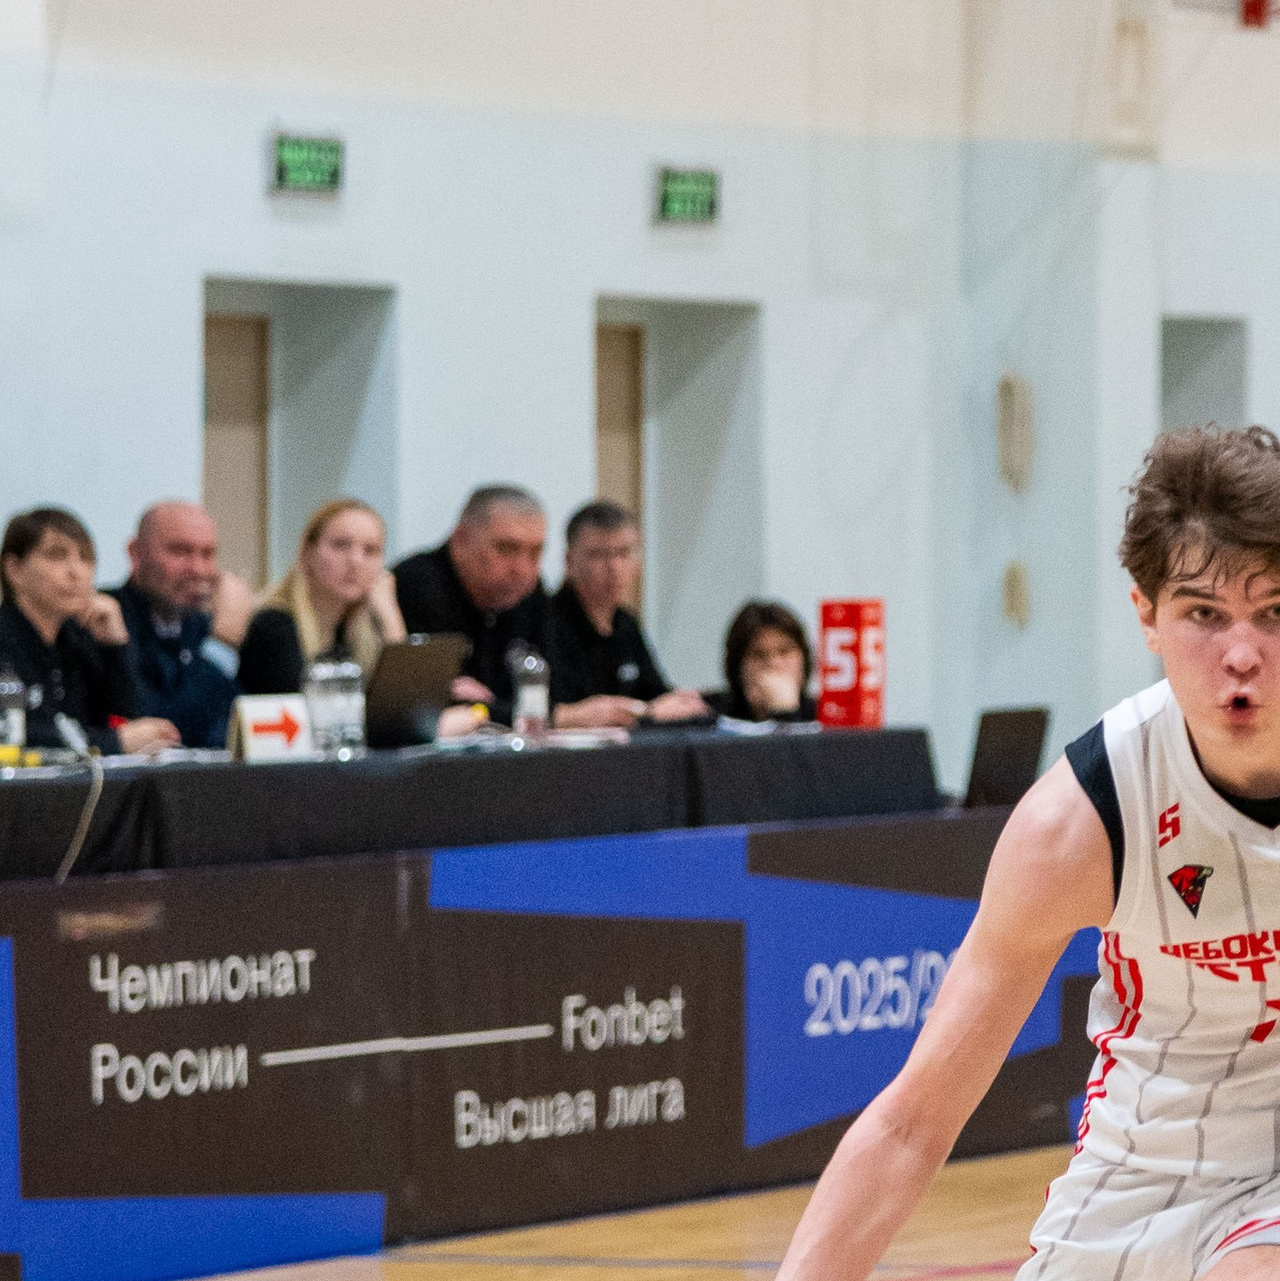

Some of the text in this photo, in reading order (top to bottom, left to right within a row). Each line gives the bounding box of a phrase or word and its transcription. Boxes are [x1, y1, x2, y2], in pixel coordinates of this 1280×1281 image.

[89, 949, 317, 1014] Чемпионат
[804, 949, 960, 1037] 2025/2
[91, 985, 685, 1105] России Fonbet
[454, 1077, 686, 1150] Высшая лига
